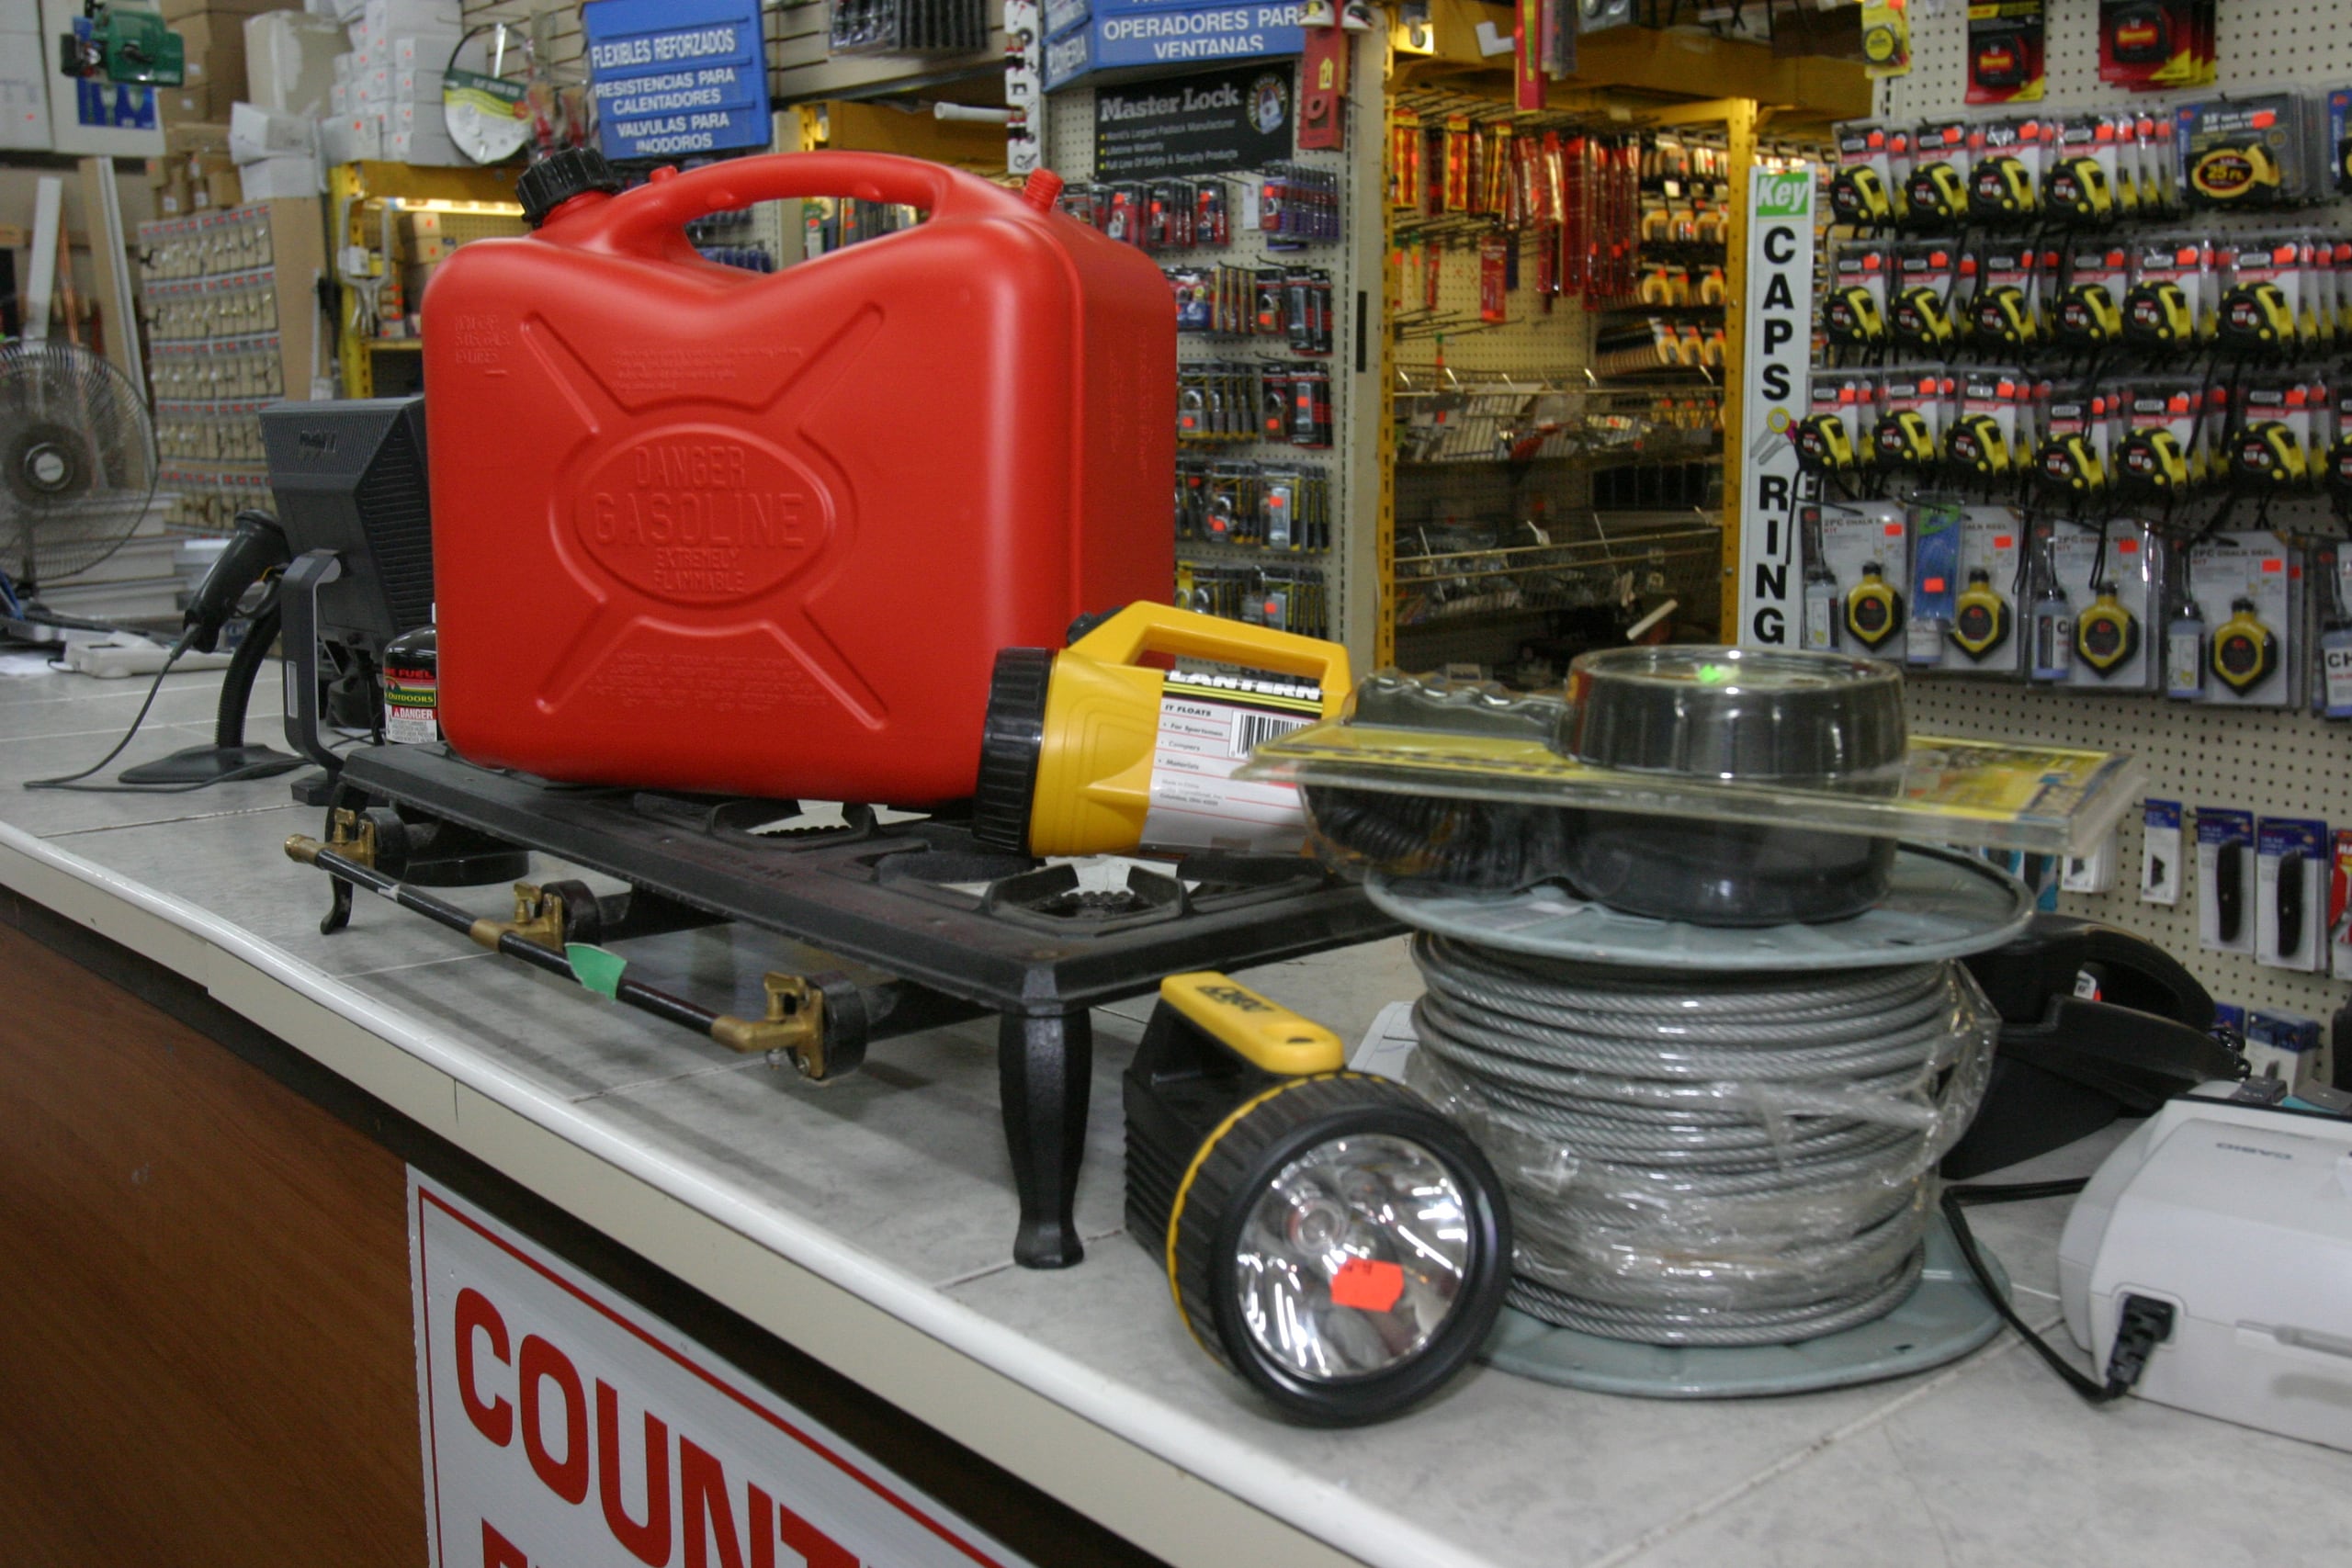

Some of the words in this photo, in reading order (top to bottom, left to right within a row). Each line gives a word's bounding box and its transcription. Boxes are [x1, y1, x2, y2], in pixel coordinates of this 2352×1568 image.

[1103, 11, 1250, 40] OPERADORES
[1258, 6, 1298, 28] PAR
[592, 39, 651, 69] FLEXIBLES
[654, 28, 735, 61] REFORZADOS
[1154, 35, 1264, 59] VENTANAS
[595, 73, 695, 98] RESISTENCIAS
[698, 67, 735, 85] PARA
[613, 88, 721, 116] CALENTADORES
[1100, 96, 1181, 122] Master
[1182, 83, 1240, 112] Lock
[616, 116, 686, 138] VALVULAS
[691, 112, 729, 130] PARA
[635, 132, 713, 153] INODOROS
[1758, 175, 1809, 212] Key
[1761, 226, 1797, 401] CAPS
[635, 445, 748, 490] DANGER
[595, 492, 805, 547] GASOLINE
[656, 547, 741, 570] EXTREMELY
[1753, 475, 1790, 644] RING
[653, 570, 746, 592] FLAMMABLE
[399, 669, 433, 679] FUEL
[1168, 670, 1321, 701] LANTERN
[400, 707, 434, 719] DANGER
[1177, 706, 1212, 717] FLOATS
[1170, 722, 1182, 730] For
[1185, 725, 1224, 737] Sportsmen
